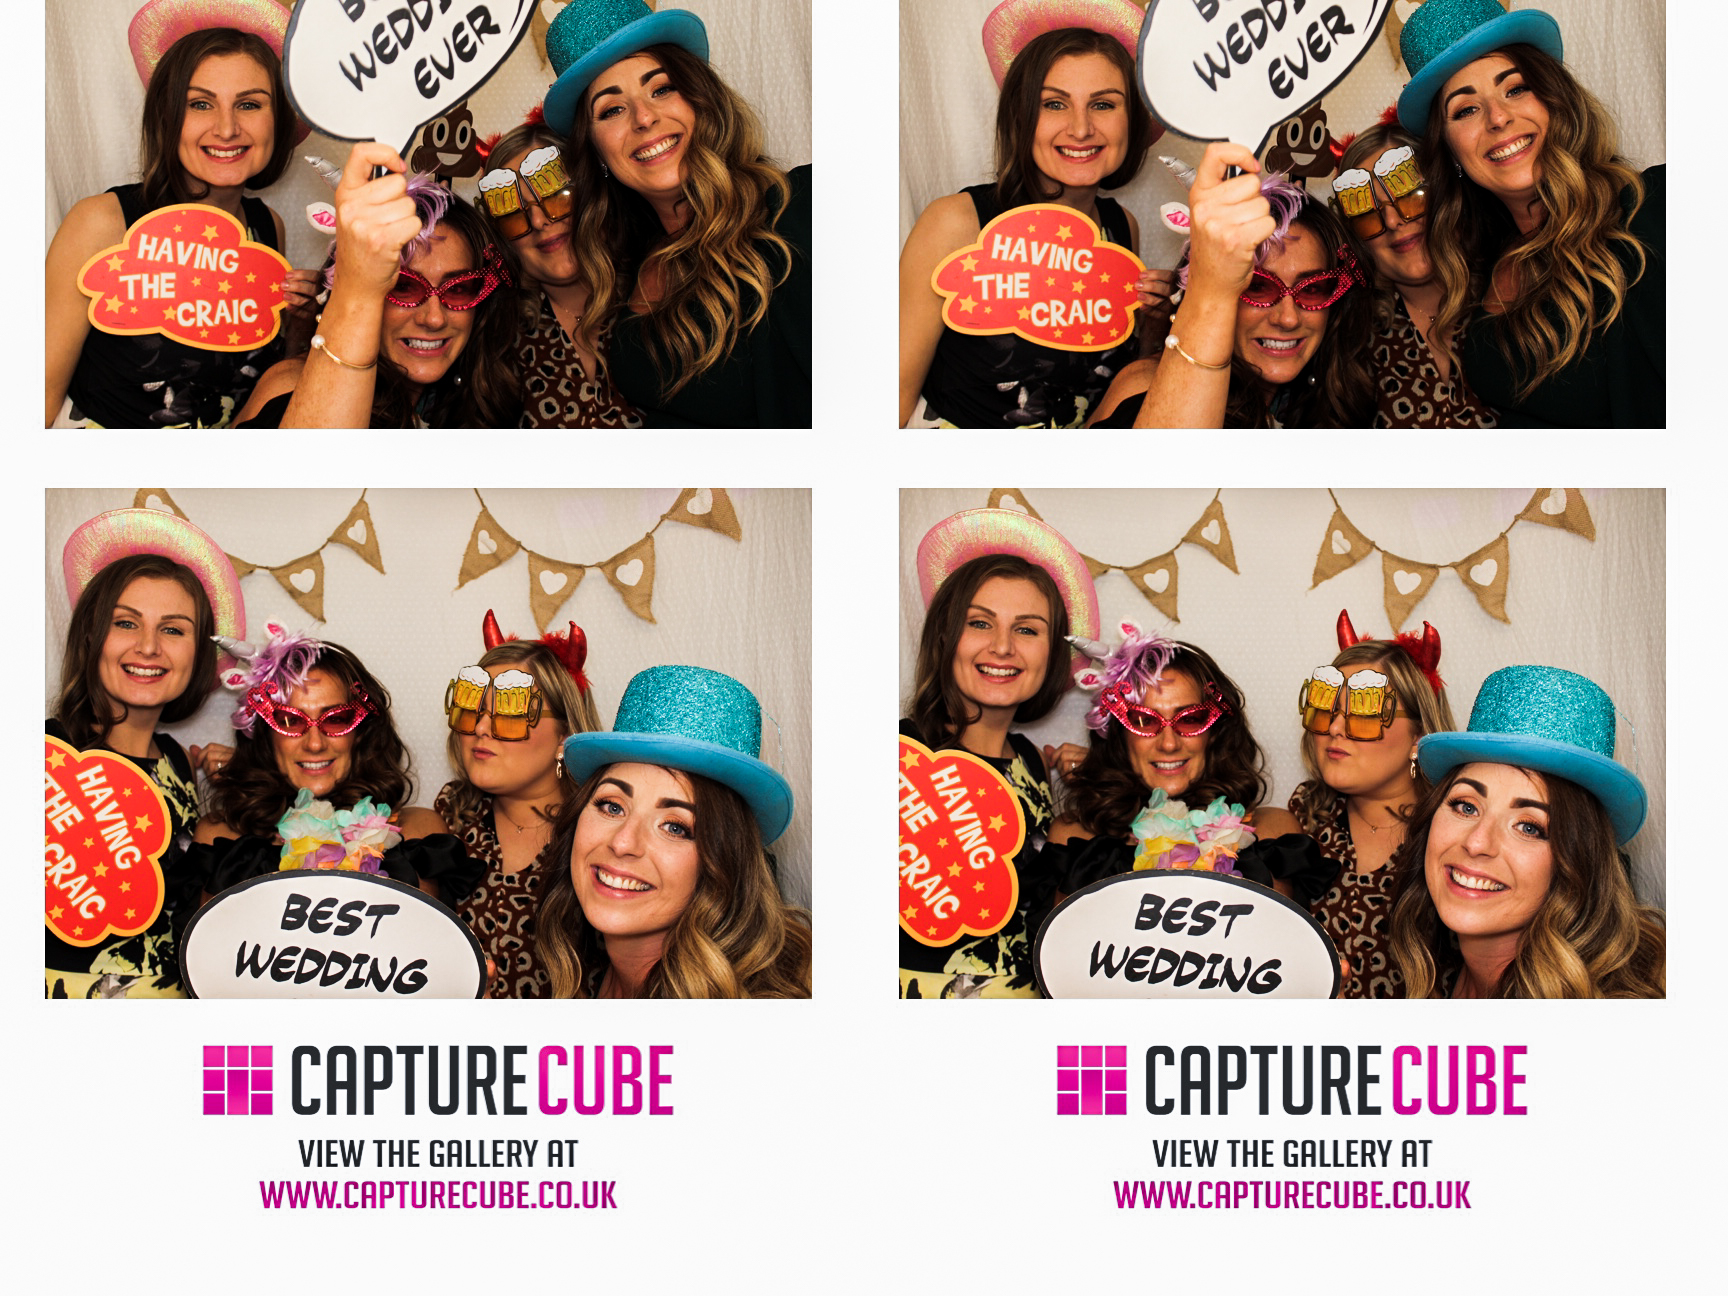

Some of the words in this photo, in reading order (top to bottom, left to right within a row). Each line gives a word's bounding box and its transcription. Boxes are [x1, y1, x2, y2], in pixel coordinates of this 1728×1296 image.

[414, 5, 501, 99] EVER
[1268, 5, 1355, 99] EVER
[137, 233, 240, 274] HAVING
[991, 233, 1094, 274] HAVING
[118, 272, 177, 301] THE
[972, 272, 1031, 301] THE
[176, 298, 259, 328] CRAIC
[1030, 298, 1113, 328] CRAIC
[75, 764, 142, 871] HAVING
[929, 764, 996, 871] HAVING
[280, 893, 401, 939] BEST
[1134, 893, 1255, 939] BEST
[235, 940, 429, 995] WEDDING
[1089, 940, 1283, 995] WEDDING
